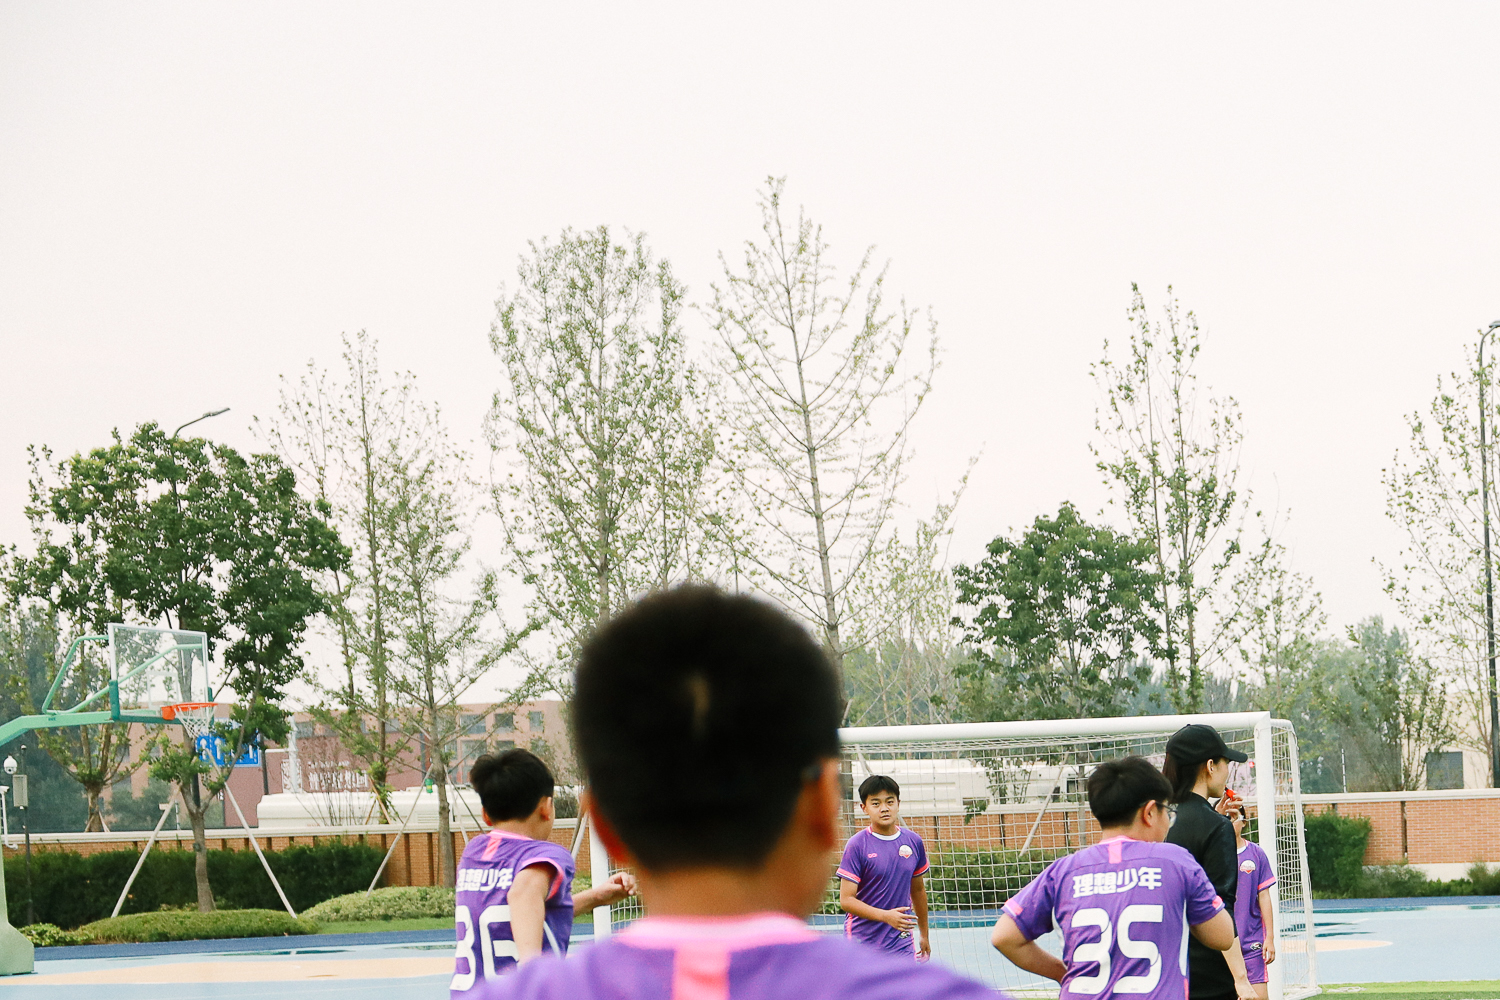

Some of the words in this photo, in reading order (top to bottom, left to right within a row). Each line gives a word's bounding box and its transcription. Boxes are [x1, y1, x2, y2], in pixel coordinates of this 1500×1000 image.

[1072, 866, 1163, 898] 理想少年
[1068, 904, 1164, 995] 35
